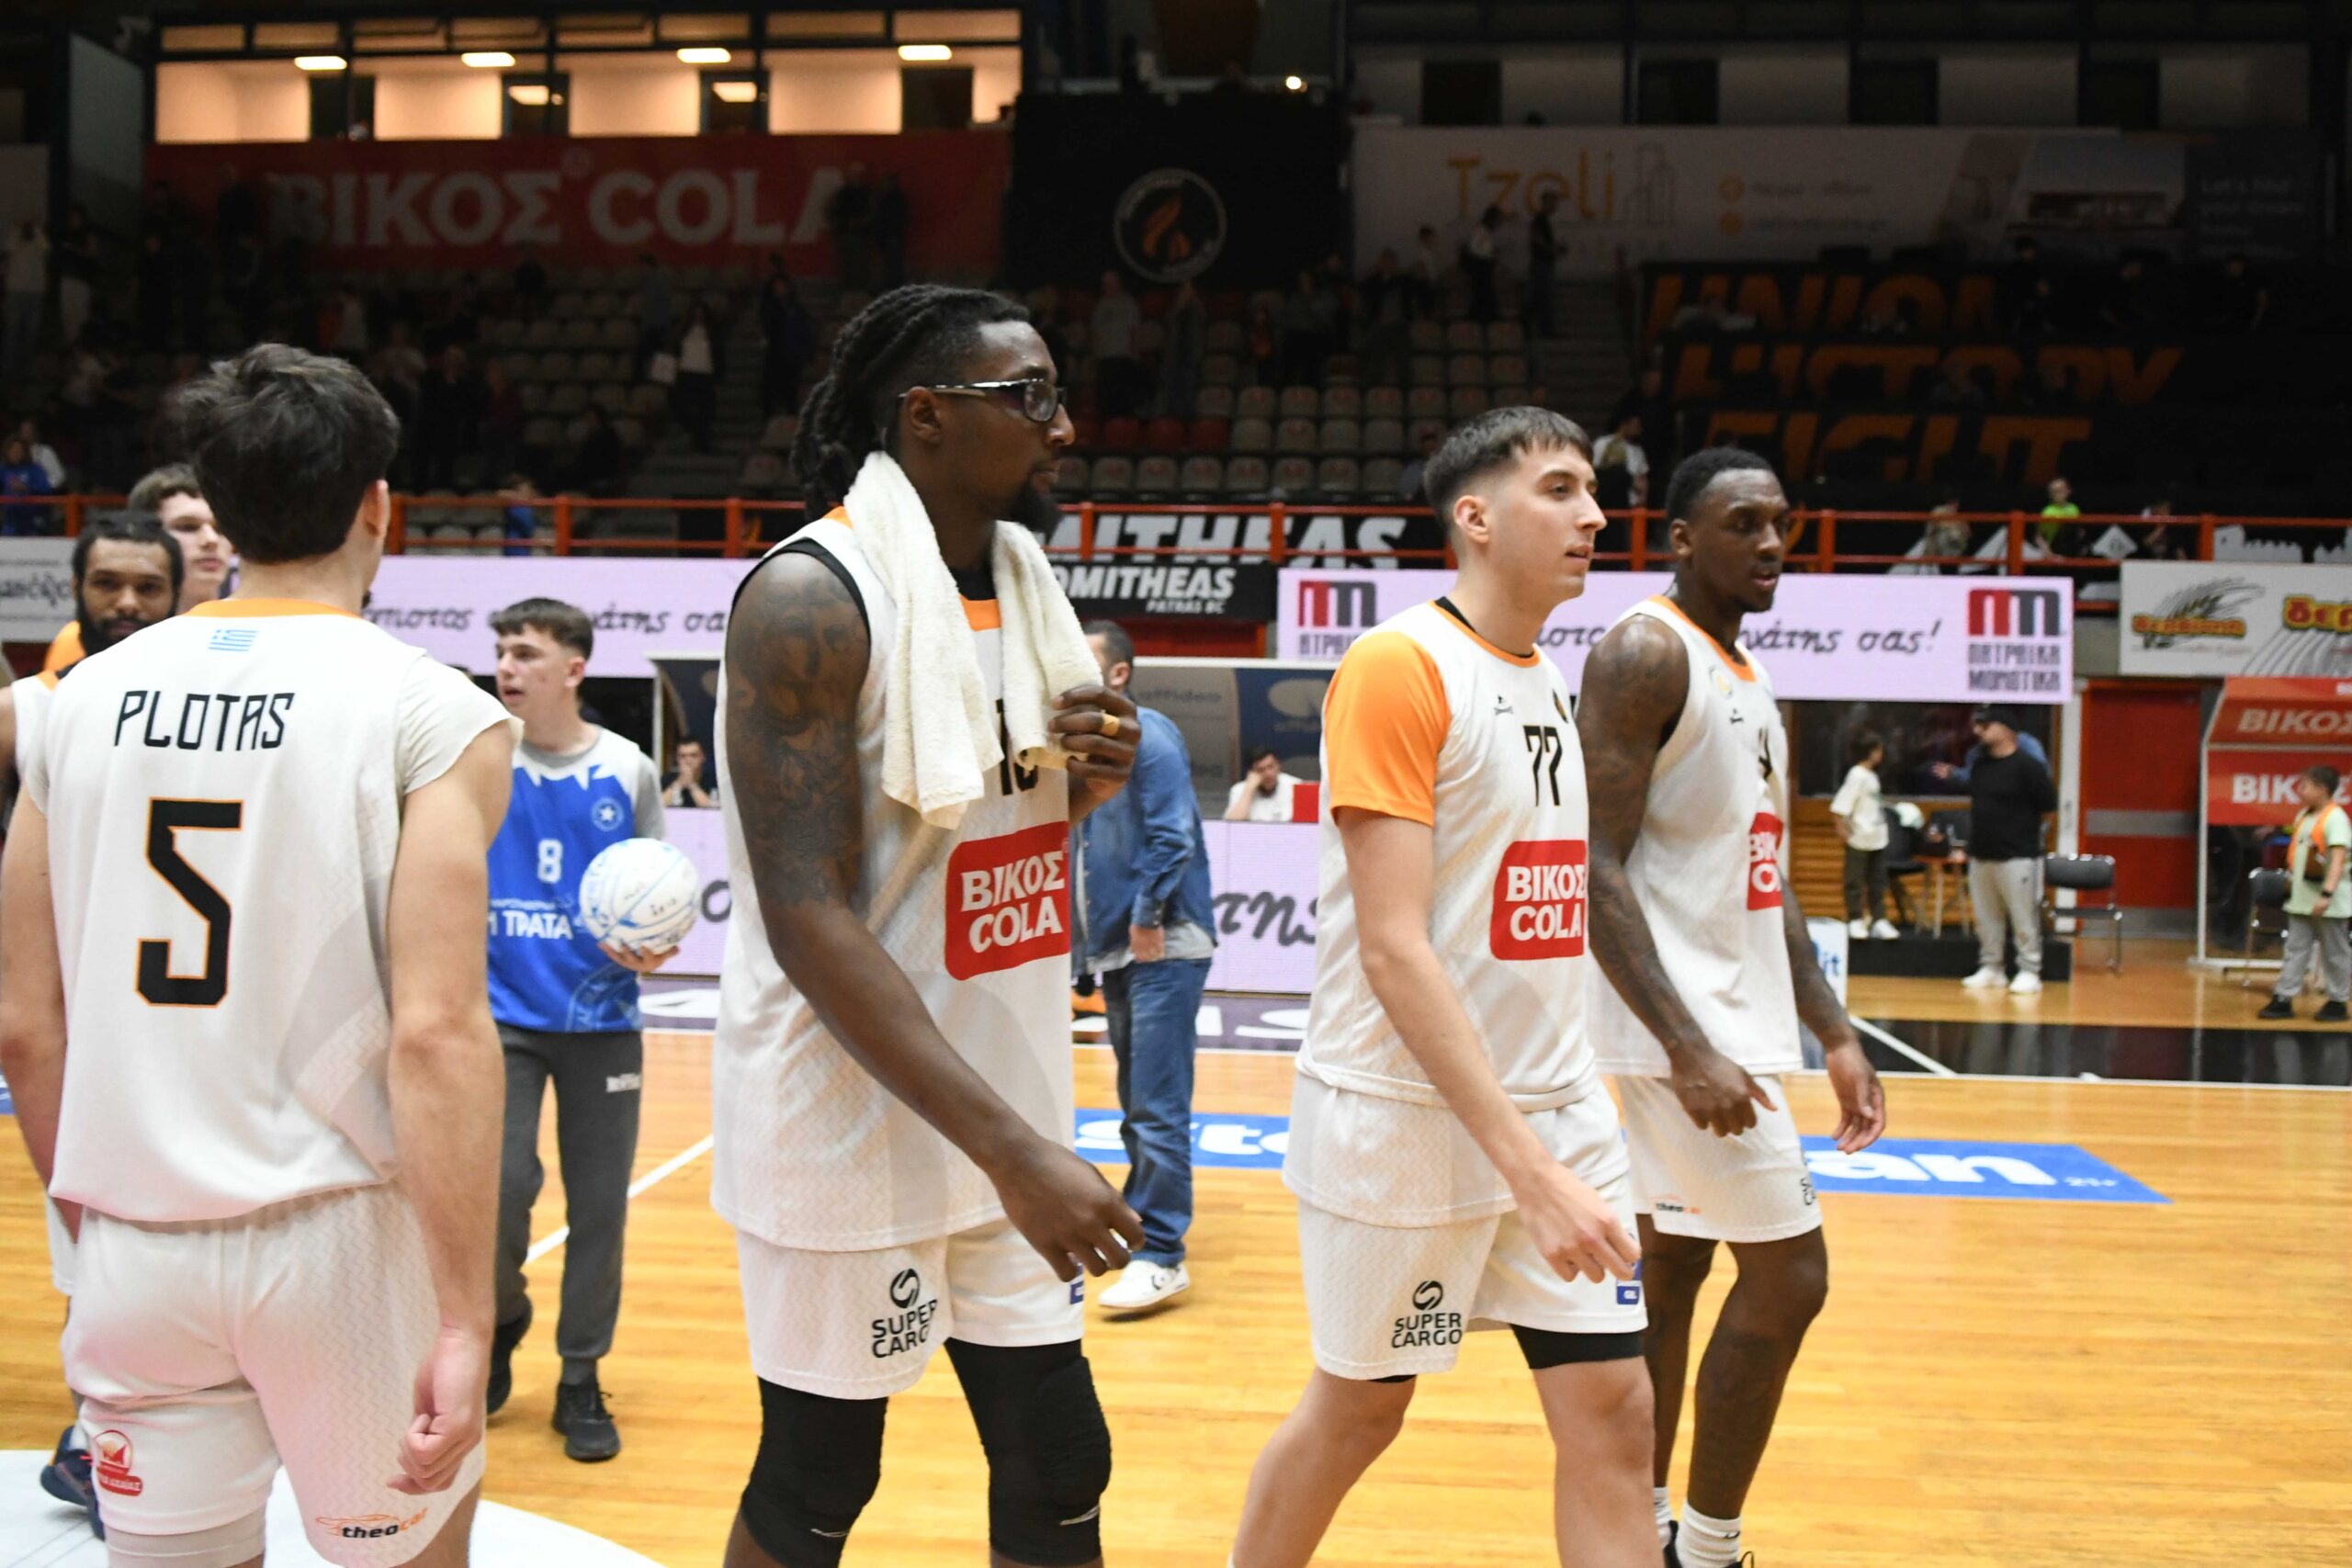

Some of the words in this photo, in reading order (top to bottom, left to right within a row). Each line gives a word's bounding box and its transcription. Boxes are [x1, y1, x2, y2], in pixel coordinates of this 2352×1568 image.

[266, 169, 563, 247] ΒΙΚΟΣ
[684, 612, 726, 632] σα
[1145, 600, 1203, 614] PATRAS
[1857, 619, 1941, 655] σας!
[114, 690, 295, 751] PLOTAS
[1522, 725, 1563, 807] 77
[2232, 773, 2352, 805] ΒΙΚΣ
[537, 838, 563, 885] 8
[960, 850, 1066, 912] ΒΙΚΟΣ
[134, 797, 243, 1007] 5
[1510, 902, 1583, 942] COLA
[502, 909, 573, 941] ΤΡΑΤΑ
[967, 895, 1064, 953] COLA
[871, 1298, 938, 1338] SUPER
[1391, 1328, 1463, 1348] CARGO
[1394, 1312, 1462, 1334] SUPER
[871, 1324, 930, 1359] CARG
